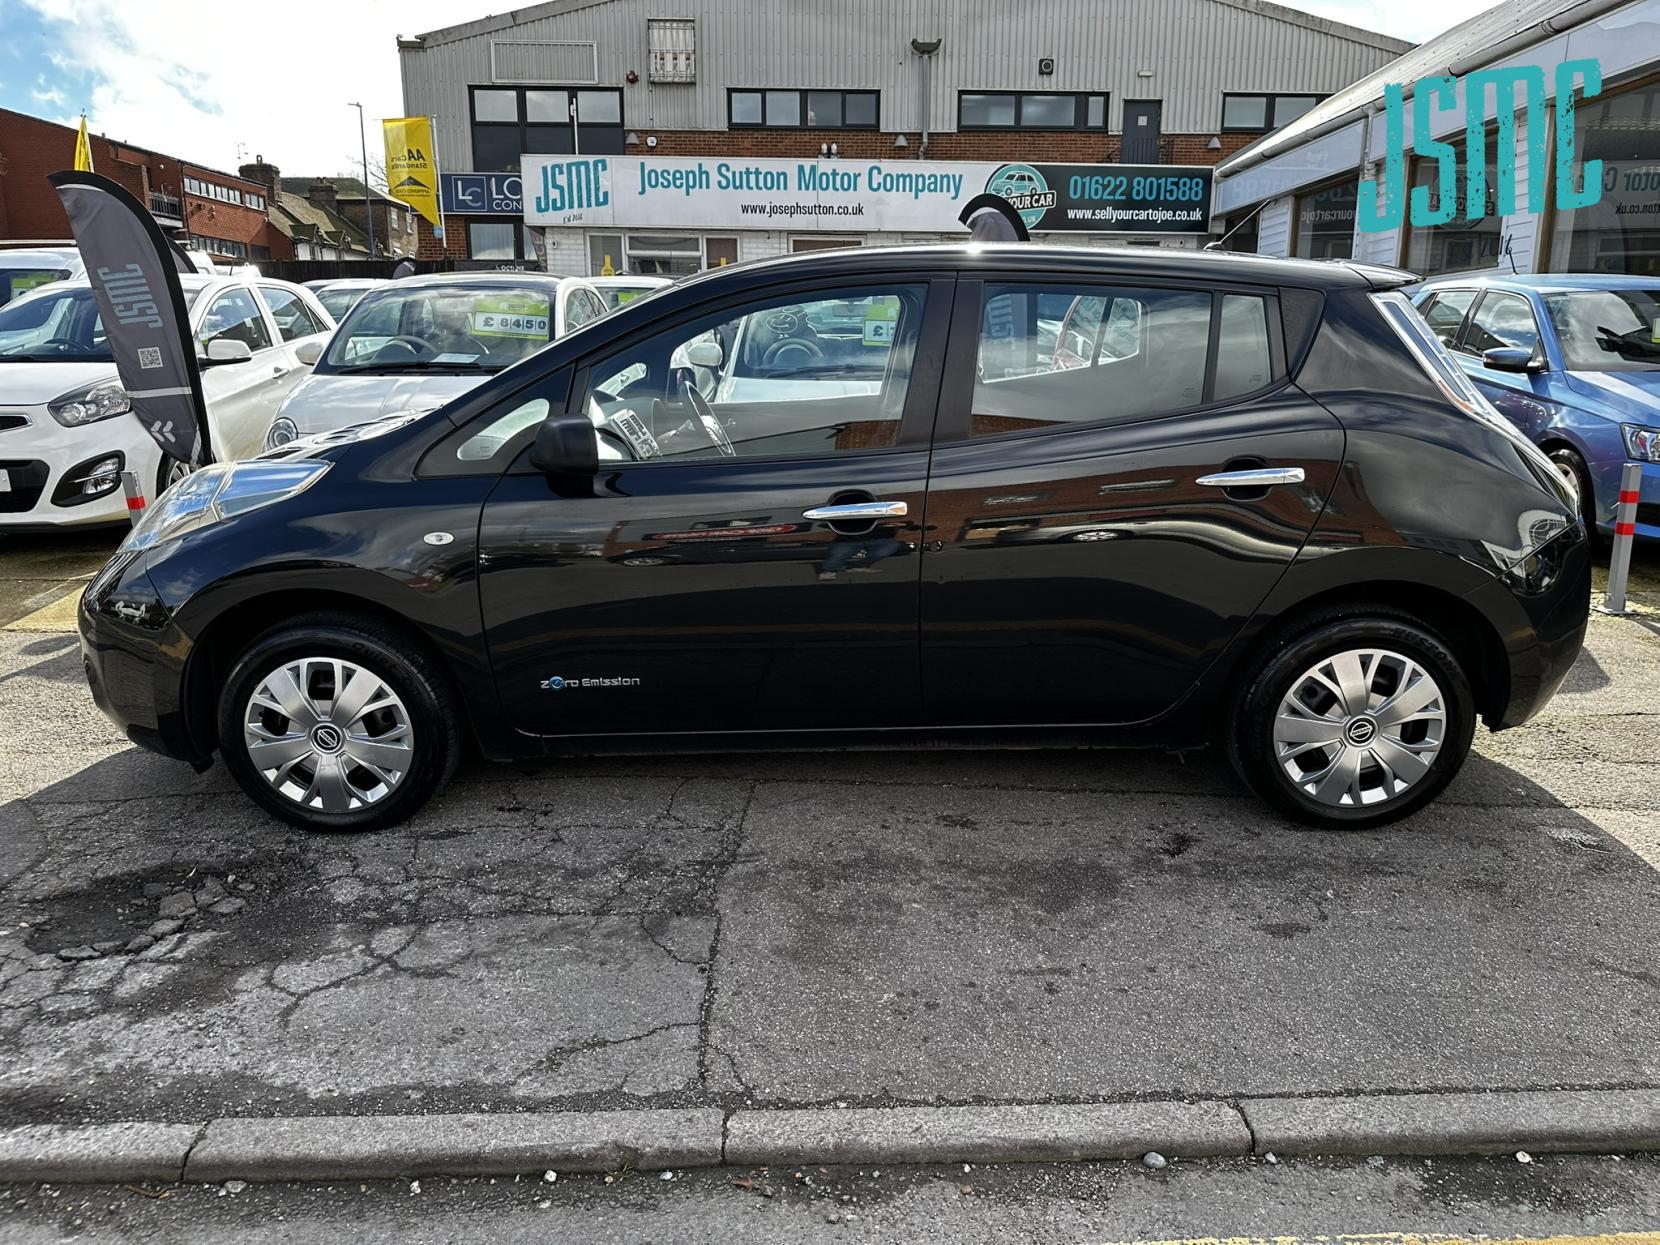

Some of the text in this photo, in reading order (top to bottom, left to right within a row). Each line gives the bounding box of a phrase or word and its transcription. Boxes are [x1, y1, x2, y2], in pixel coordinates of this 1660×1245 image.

[536, 159, 609, 213] JSMC
[638, 161, 964, 200] Joseph Sutton Motor Company
[1069, 175, 1128, 200] 01622
[1131, 177, 1204, 201] 801588
[741, 202, 864, 218] www.josephsutton.co.uk
[1032, 194, 1053, 207] CAR
[1067, 206, 1202, 224] www.sellyourcartojoe.co.uk
